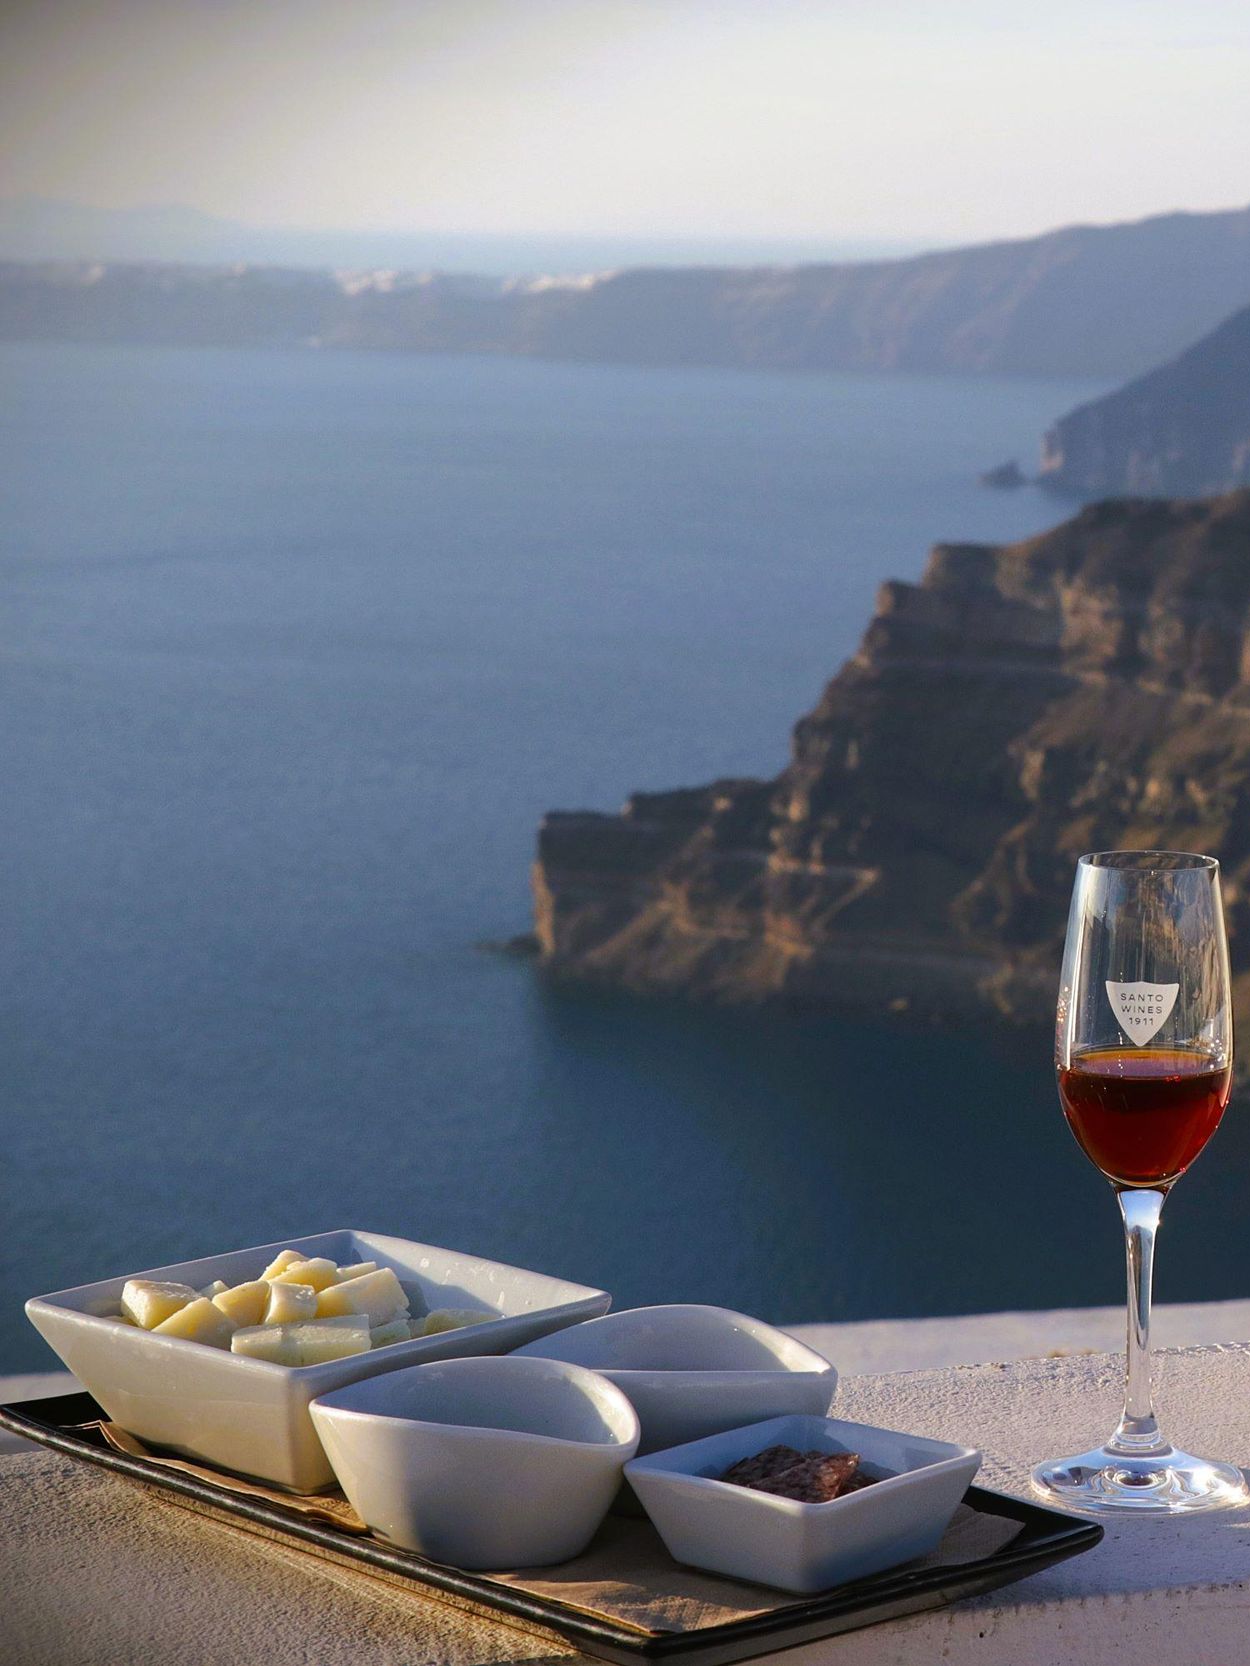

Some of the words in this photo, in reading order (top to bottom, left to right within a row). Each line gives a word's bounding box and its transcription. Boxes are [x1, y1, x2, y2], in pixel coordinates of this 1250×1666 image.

[1120, 993, 1164, 1002] SANTO
[1121, 1005, 1163, 1014] WINES
[1128, 1017, 1154, 1026] 1911
